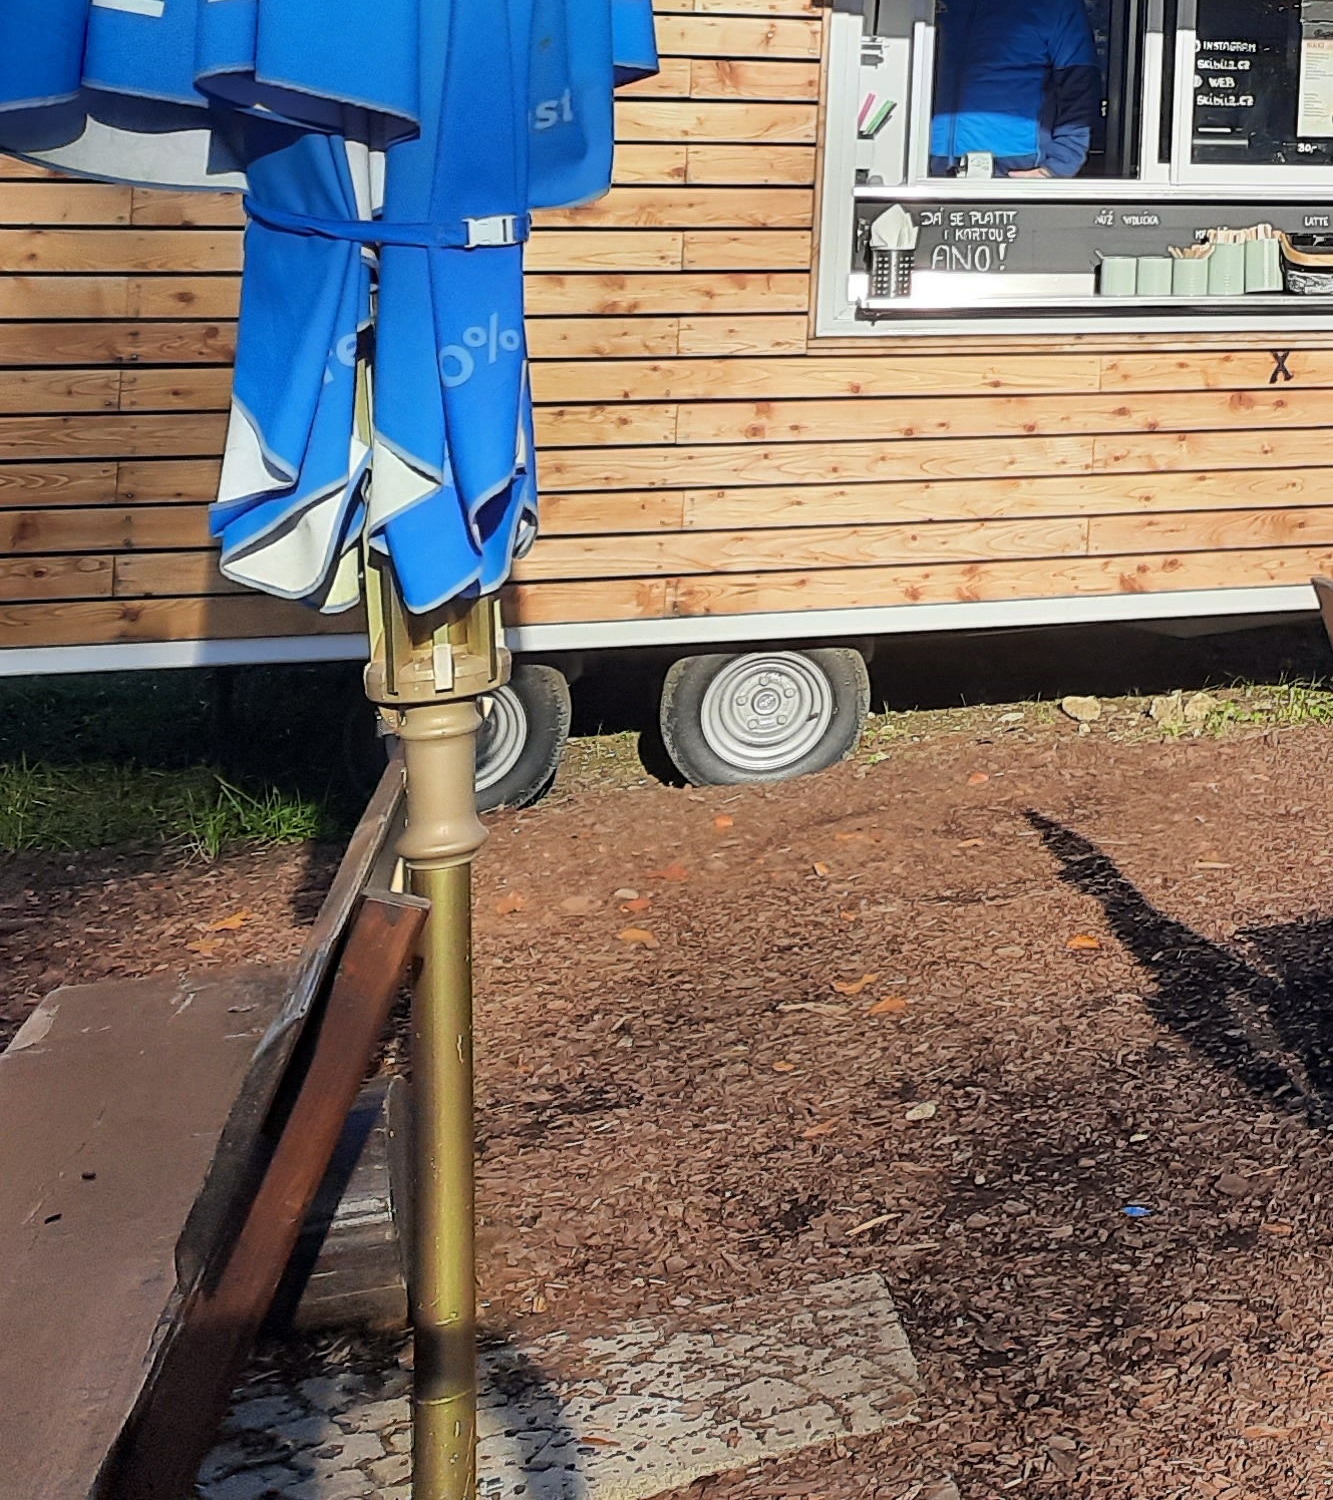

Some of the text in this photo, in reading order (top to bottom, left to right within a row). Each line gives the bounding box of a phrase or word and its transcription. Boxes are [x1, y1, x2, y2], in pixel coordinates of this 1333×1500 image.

[1203, 41, 1256, 52] INSTAGRAM
[1208, 77, 1235, 88] WEB
[920, 206, 1018, 226] DÁ SE PLATIT
[1304, 216, 1329, 227] LATTE
